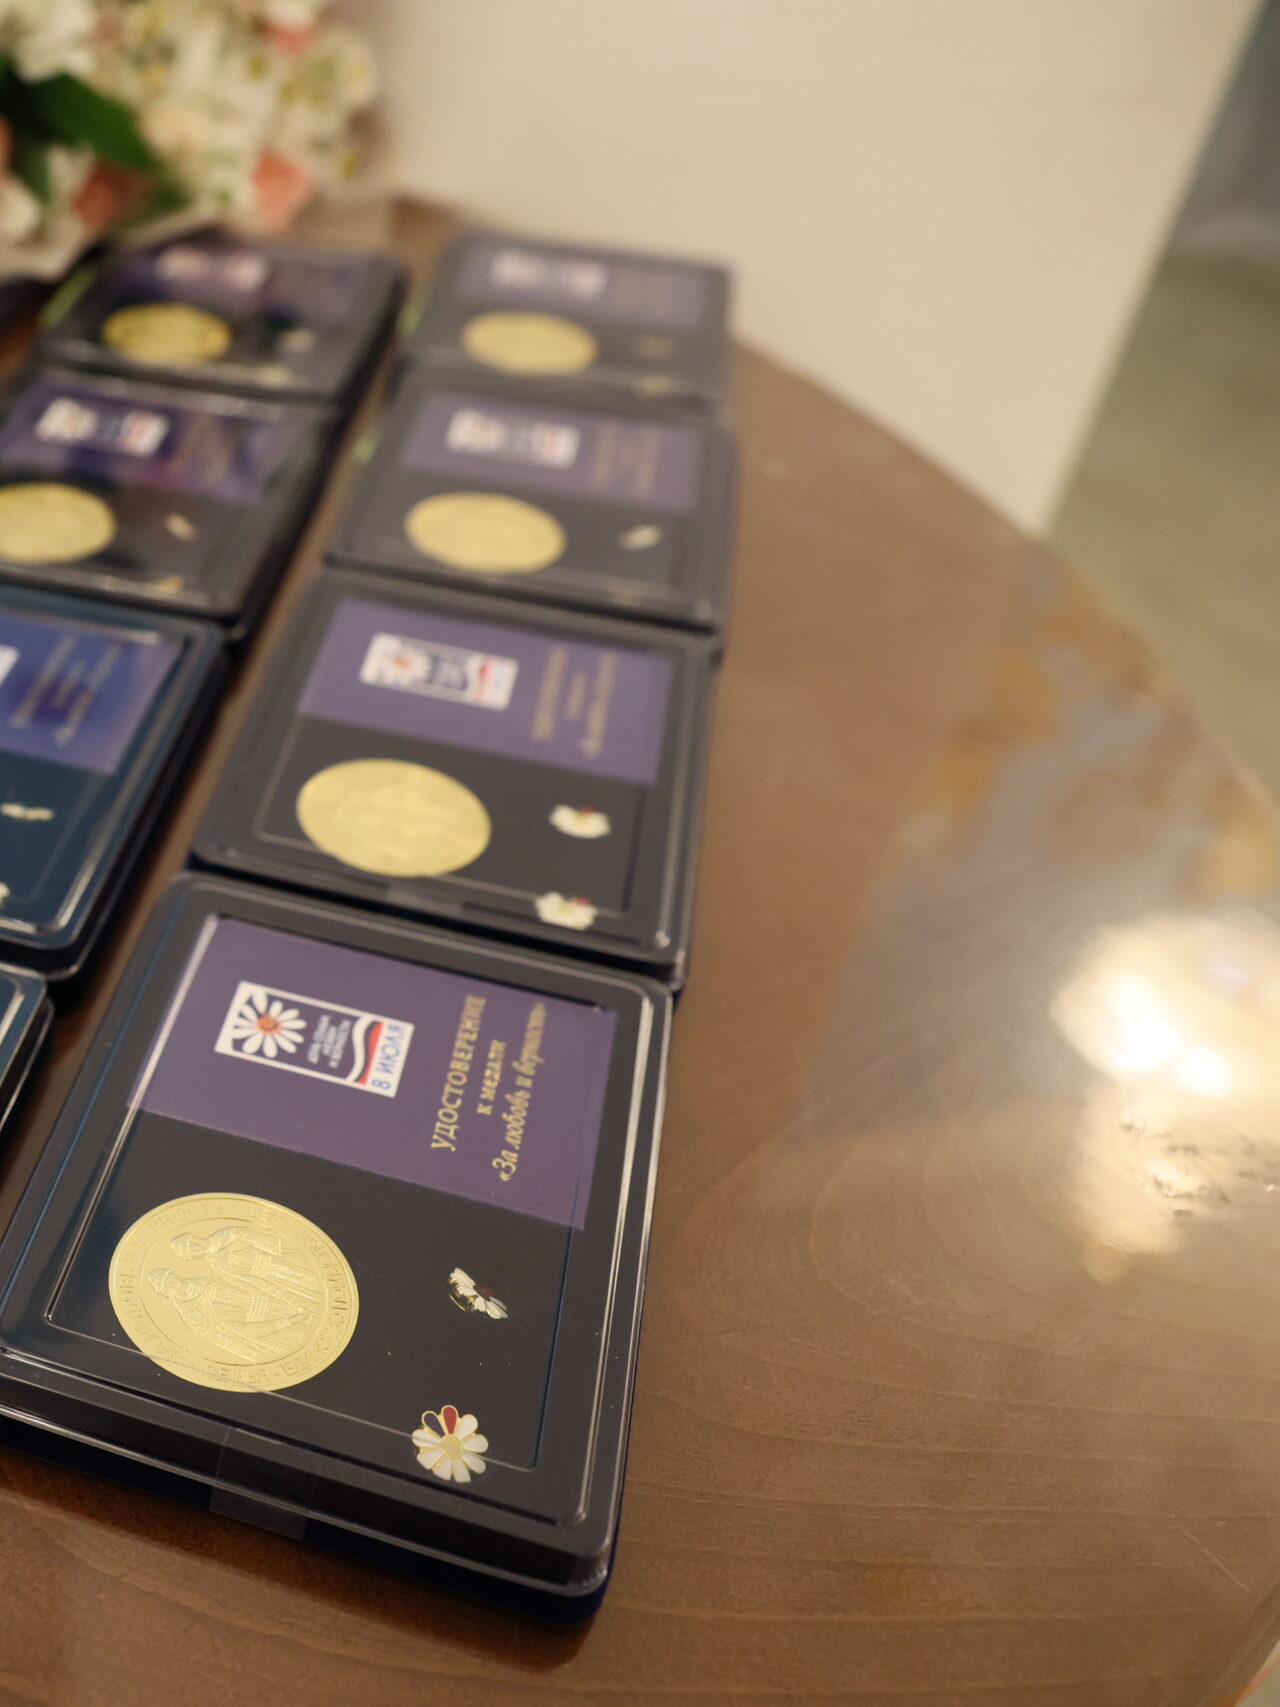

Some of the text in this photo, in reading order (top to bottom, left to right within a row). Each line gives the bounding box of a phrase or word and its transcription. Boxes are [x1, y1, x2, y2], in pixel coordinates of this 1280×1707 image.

[372, 1023, 406, 1091] 8 ИЮЛЯ
[431, 994, 486, 1152] УДОСТОВЕРЕНИЕ
[476, 1040, 508, 1116] к медали
[522, 1073, 535, 1089] и
[502, 1087, 532, 1151] любовь
[492, 1152, 519, 1182] «За
